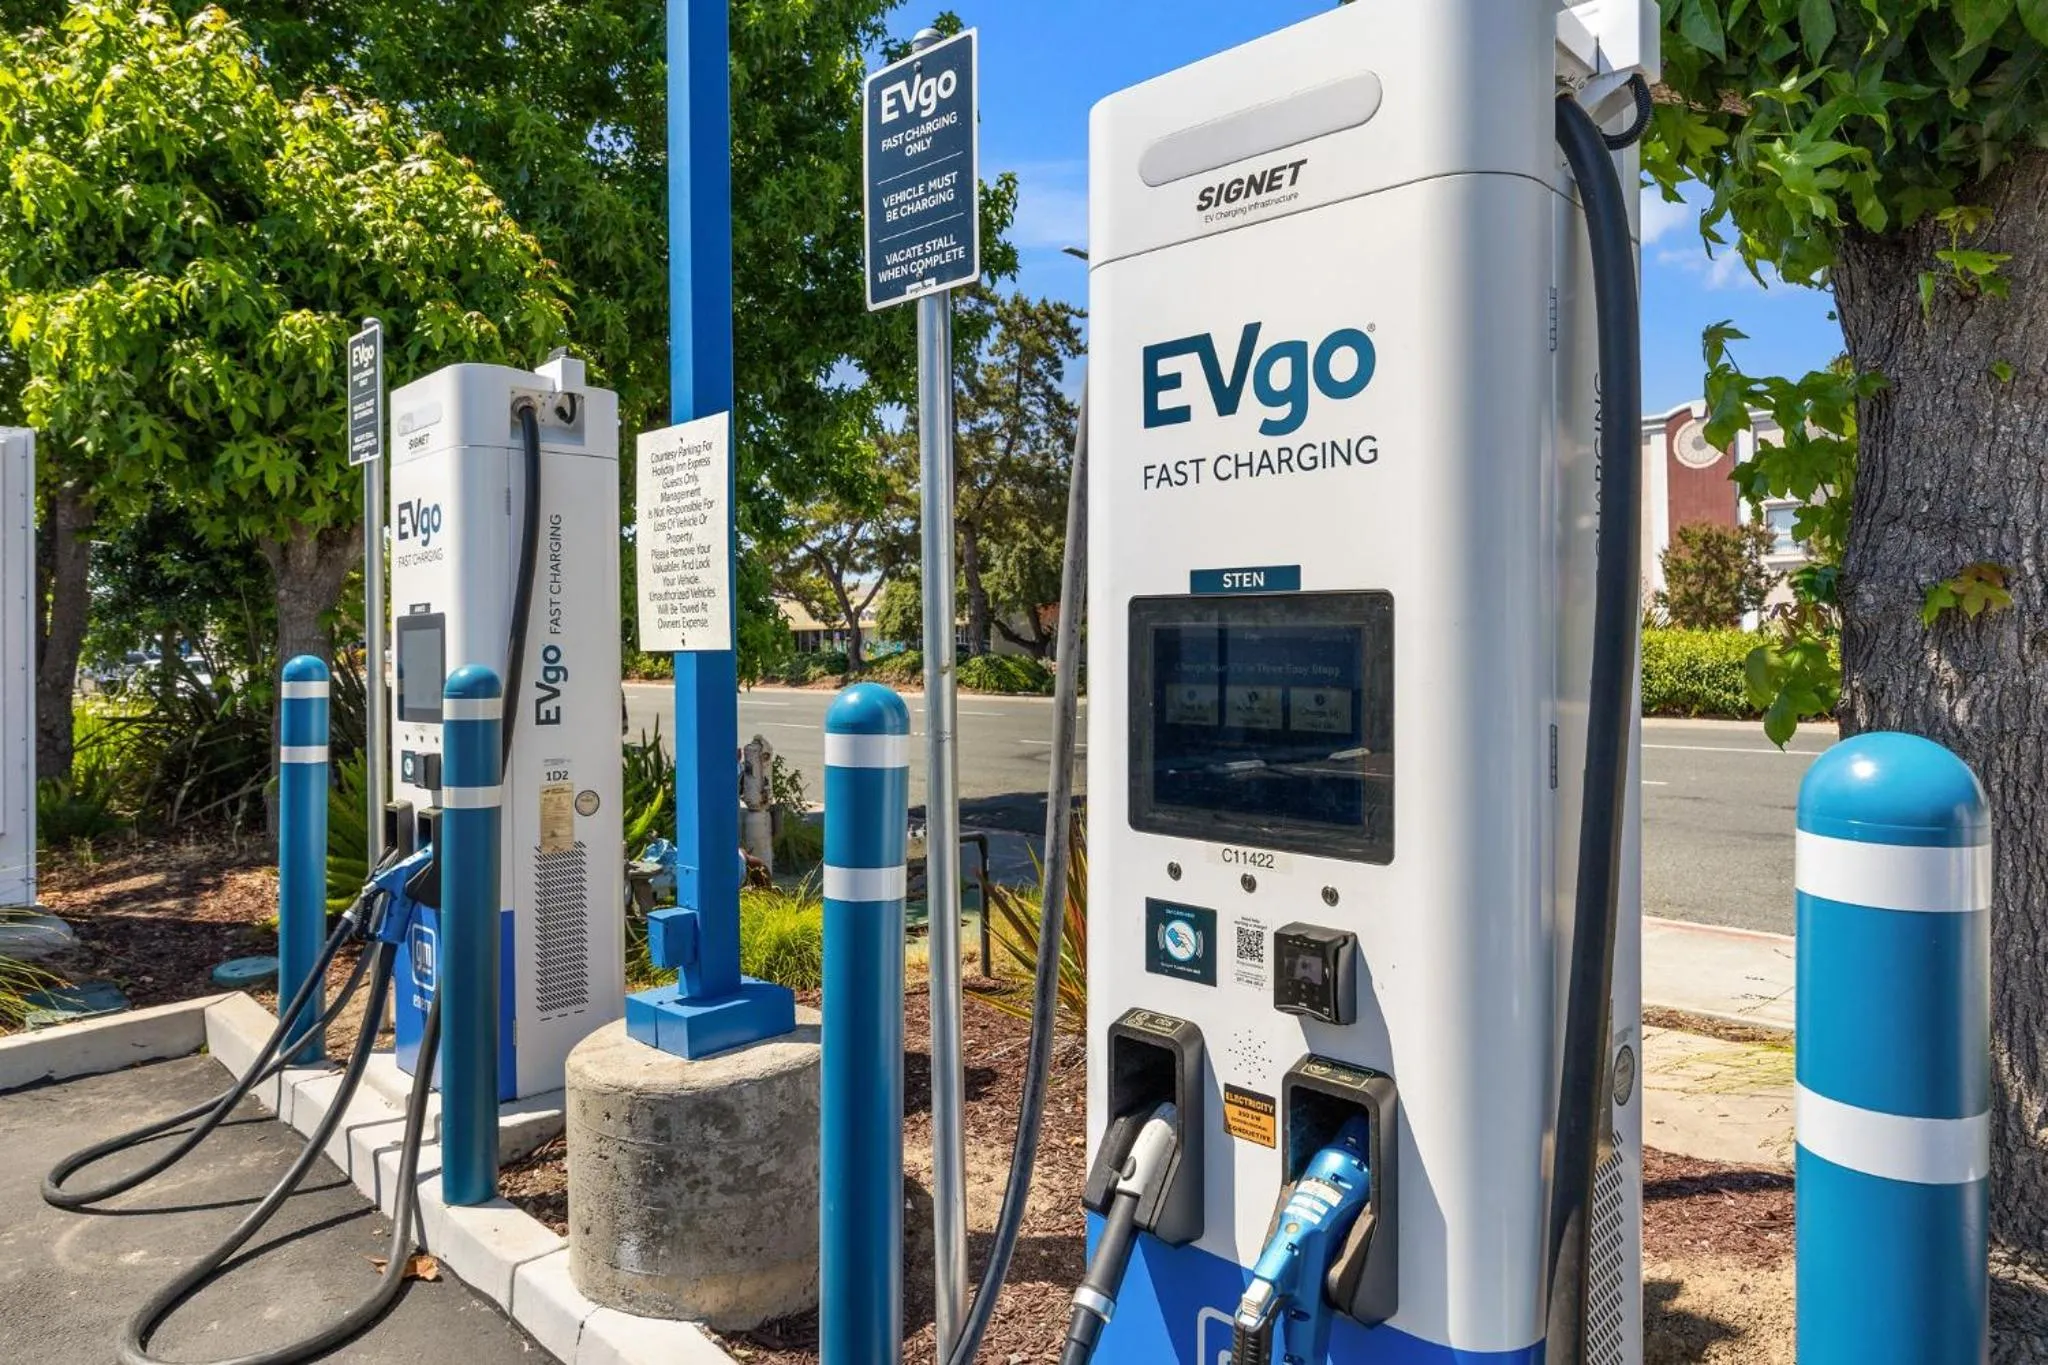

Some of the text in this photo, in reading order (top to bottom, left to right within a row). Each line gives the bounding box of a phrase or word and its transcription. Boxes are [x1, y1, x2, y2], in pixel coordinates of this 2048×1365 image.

[881, 70, 957, 125] EVgo
[881, 111, 958, 152] FAST CHARGING
[905, 136, 933, 157] ONLY
[882, 171, 958, 208] VEHICLE MUST
[1197, 158, 1308, 212] SIGNET
[885, 189, 955, 222] BE CHARGING
[1205, 192, 1300, 224] EV Charging Infrastructure
[885, 234, 957, 266] VACATE STALL
[878, 246, 966, 283] WHEN COMPLETE
[352, 342, 375, 368] EVgo
[1143, 321, 1376, 437] EVgo
[650, 440, 713, 464] Courtesy Parking For
[651, 465, 674, 477] Holiday
[688, 457, 711, 471] Express
[1143, 435, 1379, 491] FAST CHARGING
[662, 477, 683, 489] Guests
[660, 487, 701, 503] Management
[653, 507, 665, 518] Not
[666, 501, 702, 516] Responsible
[703, 498, 715, 509] For
[398, 498, 442, 547] EVgo
[653, 522, 666, 532] Loss
[677, 516, 698, 528] Vehicle
[699, 513, 708, 525] Or
[398, 547, 443, 568] FAST CHARGING
[651, 543, 711, 560] Please Remove Your
[550, 513, 562, 635] FAST CHARGING
[652, 557, 711, 574] Valuables And Lock
[662, 576, 676, 587] Your
[1223, 571, 1264, 588] STEN
[649, 590, 690, 601] Unauthorized
[670, 603, 678, 615] Be
[679, 602, 699, 613] Towed
[535, 645, 568, 725] EVgo
[546, 770, 569, 781] 1D2
[1221, 848, 1274, 868] C11422
[1225, 1092, 1274, 1113] ELECTRICITY
[1227, 1123, 1271, 1143] CONDUCTIVE
